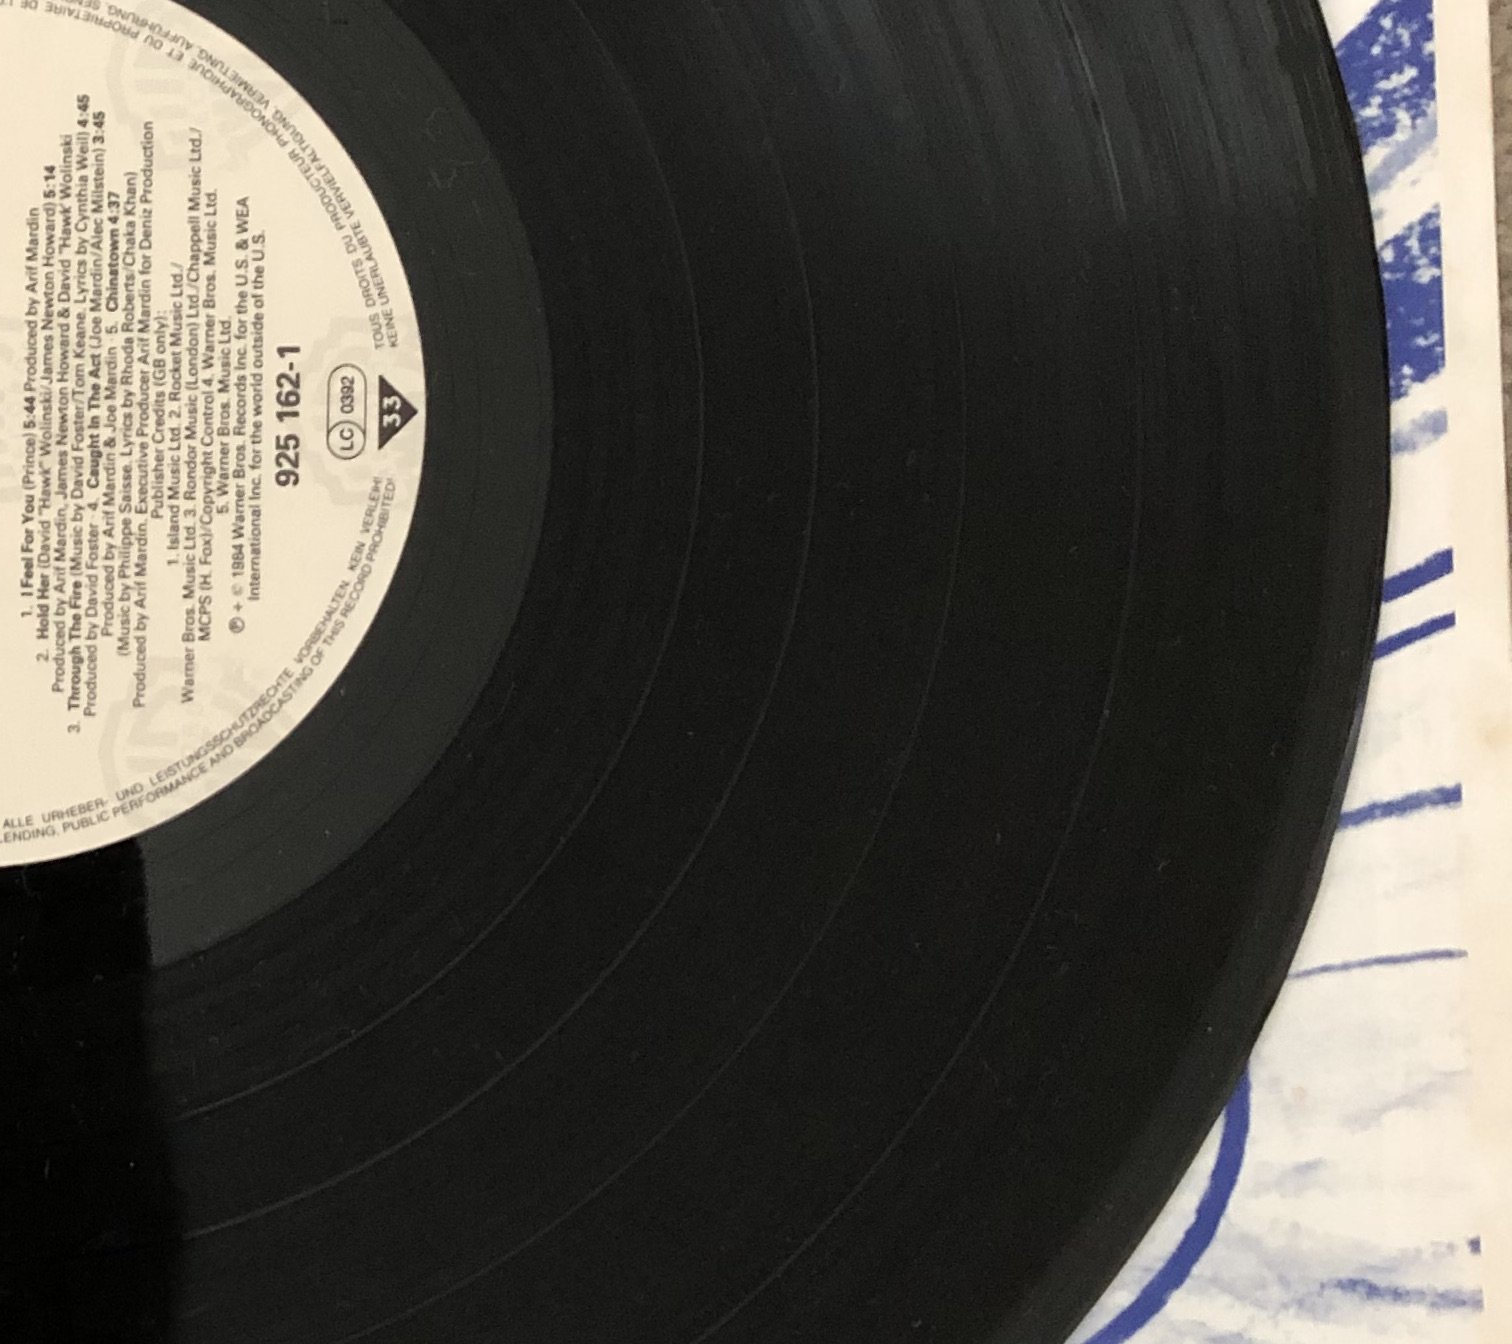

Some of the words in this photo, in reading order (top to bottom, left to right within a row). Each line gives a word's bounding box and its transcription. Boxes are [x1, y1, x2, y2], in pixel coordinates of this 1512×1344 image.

[77, 94, 89, 128] 4:45
[92, 111, 105, 145] 3:45
[76, 131, 89, 172] Weil)
[43, 165, 56, 199] 5:14
[91, 148, 105, 214] Milstein)
[74, 175, 89, 233] Cynthia
[107, 191, 120, 225] 4:37
[236, 197, 248, 235] WEA
[26, 207, 39, 262] Mardin
[42, 202, 56, 268] Howard)
[75, 236, 88, 256] by
[235, 238, 248, 251] &
[25, 265, 38, 294] Arif
[74, 259, 88, 304] Lyrics
[106, 228, 119, 313] Chinatown
[25, 297, 39, 317] by
[41, 271, 54, 331] Newton
[235, 290, 247, 315] the
[89, 316, 102, 350] (Joe
[169, 301, 183, 347] Music
[233, 318, 247, 341] for
[23, 320, 37, 393] Produced
[88, 353, 101, 380] Act
[104, 346, 117, 401] Mardin
[152, 358, 166, 387] (GB
[168, 351, 181, 402] Rocket
[275, 346, 300, 423] 162-1
[340, 376, 354, 414] 0392
[23, 396, 36, 429] 5:44
[88, 382, 101, 412] The
[233, 374, 246, 436] Records
[381, 395, 403, 428] 33
[87, 415, 100, 430] In
[103, 404, 117, 434] Joe
[151, 390, 165, 445] Credits
[103, 436, 116, 449] &
[339, 429, 354, 451] LC
[22, 433, 37, 491] (Prince)
[70, 456, 84, 500] David
[86, 433, 102, 490] Caught
[102, 452, 116, 507] Mardin
[167, 455, 180, 500] Music
[275, 434, 300, 487] 925
[151, 447, 164, 520] Publisher
[22, 494, 34, 525] You
[70, 503, 84, 523] by
[102, 510, 114, 539] Arif
[167, 504, 180, 550] Island
[232, 483, 245, 540] Warner
[21, 528, 34, 554] For
[37, 520, 51, 570] (David
[69, 526, 83, 577] (Music
[85, 523, 99, 570] Foster
[102, 542, 116, 561] by
[20, 557, 33, 589] Feel
[231, 543, 244, 578] 1984
[37, 573, 49, 600] Her
[68, 580, 82, 610] Fire
[85, 574, 98, 618] David
[101, 565, 114, 637] Produced
[36, 603, 49, 640] Hold
[68, 613, 81, 642] The
[85, 622, 99, 641] by
[68, 645, 82, 712] Through
[83, 644, 97, 717] Produced
